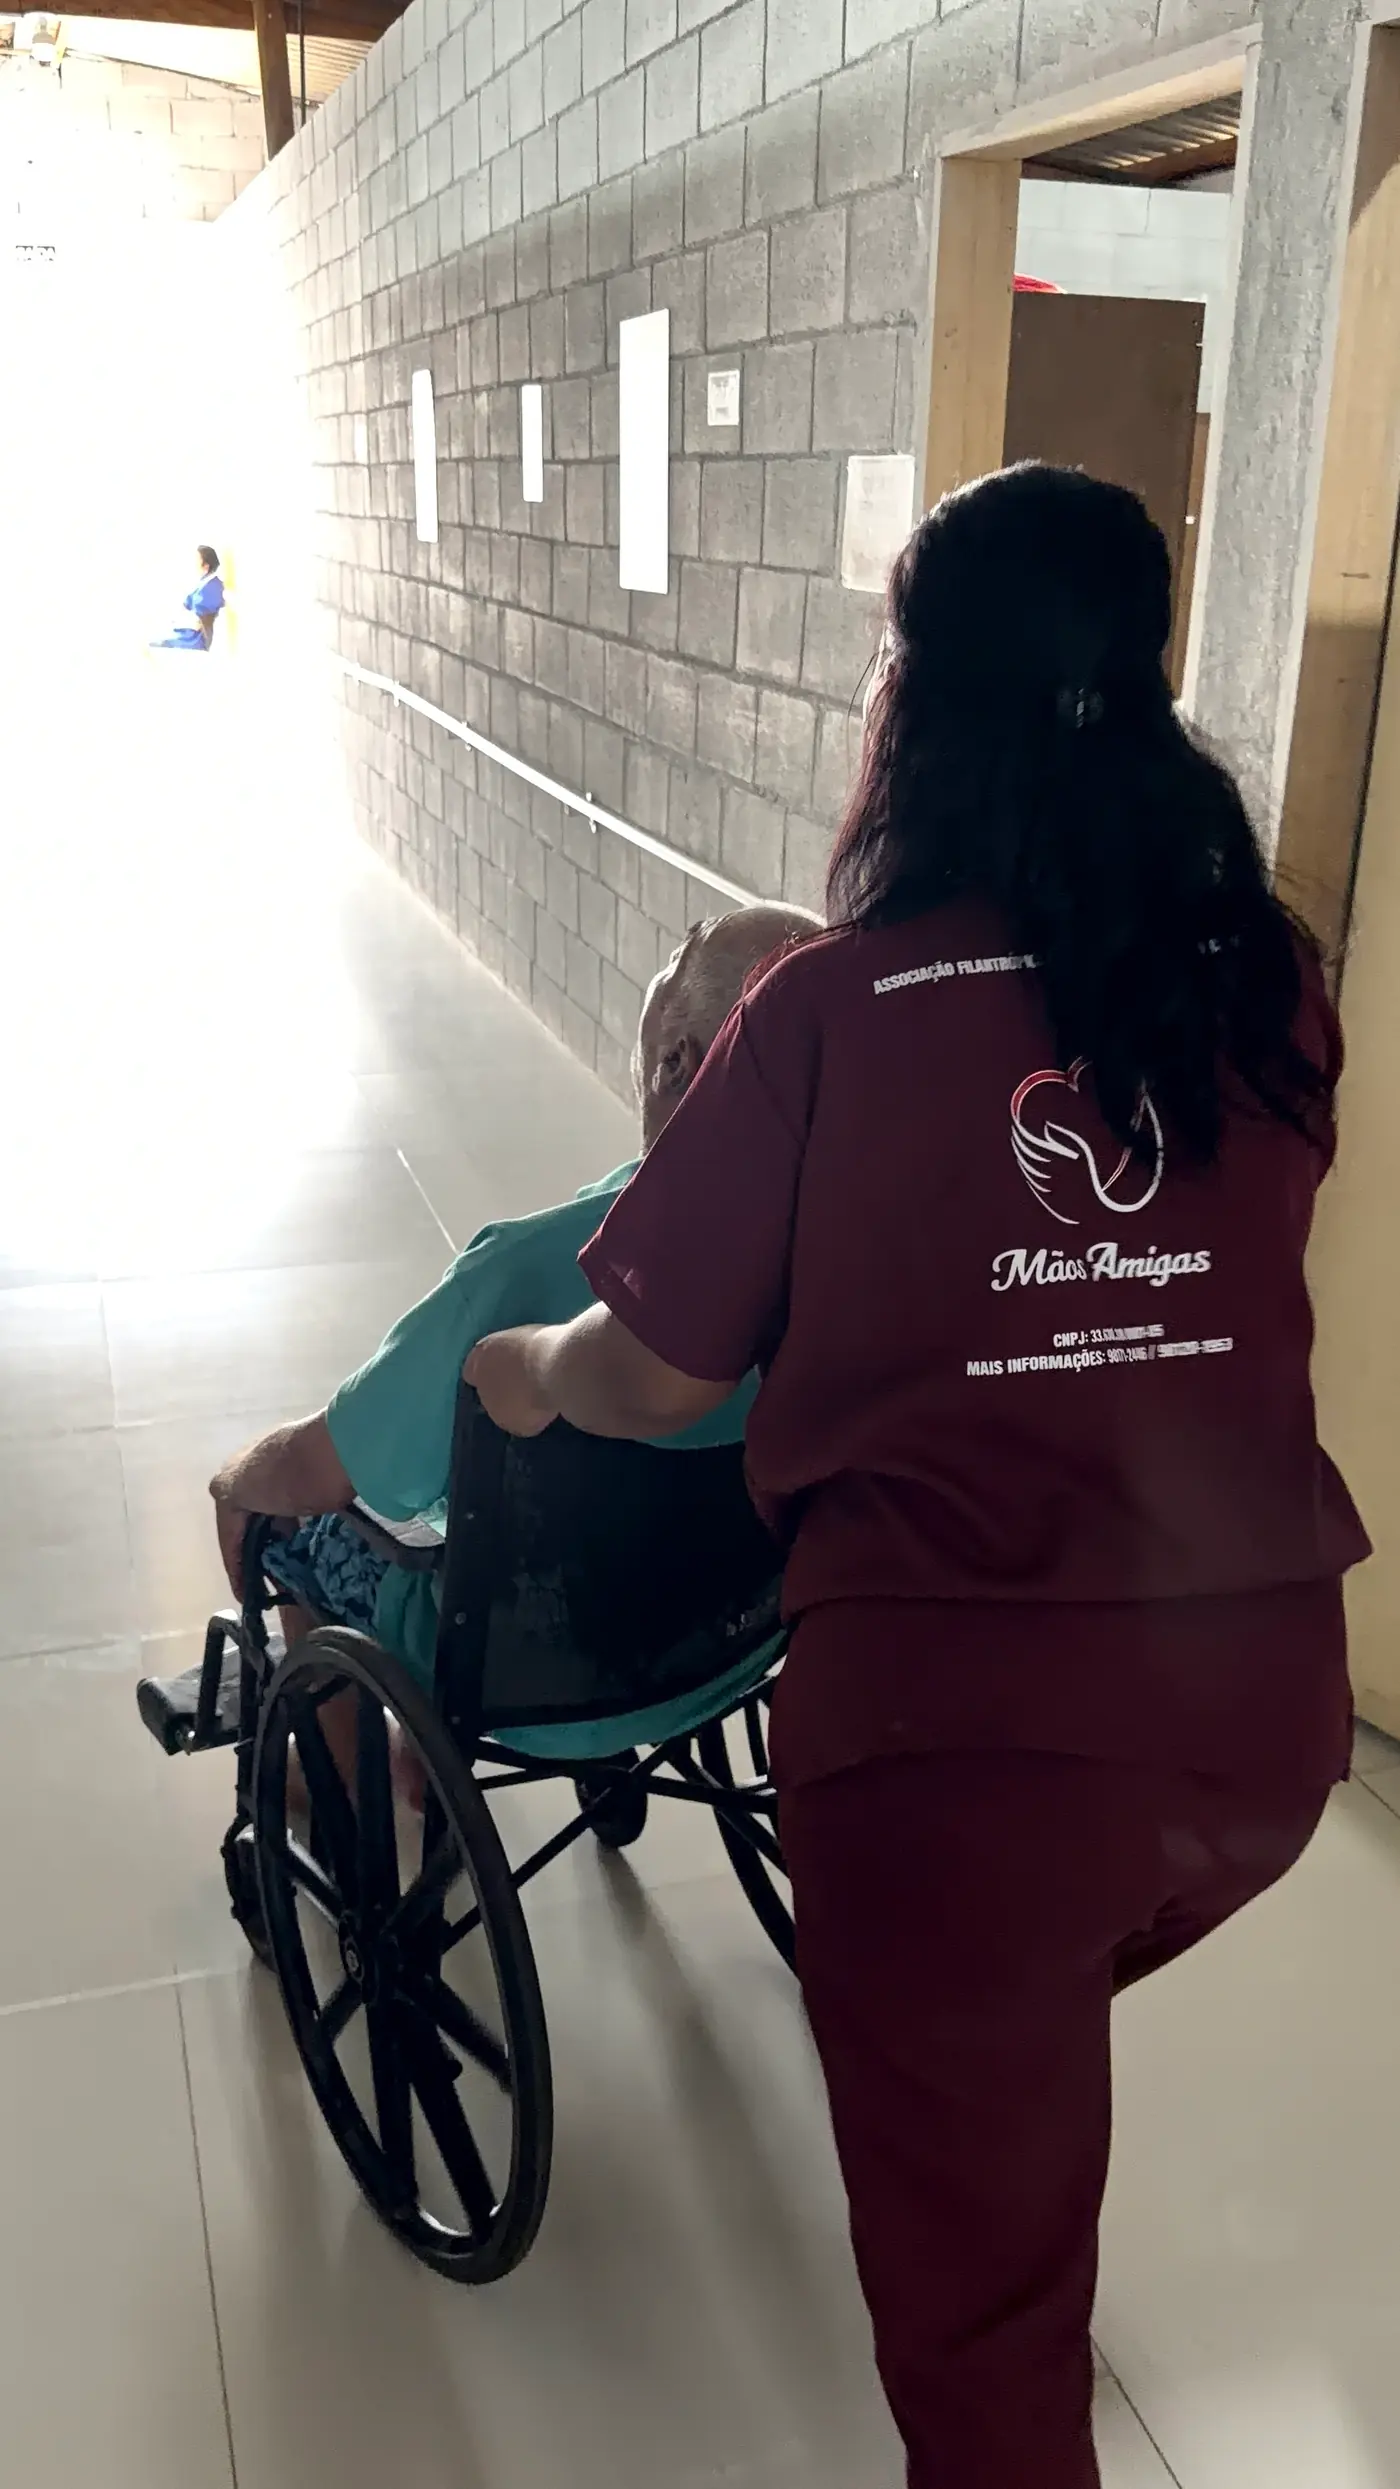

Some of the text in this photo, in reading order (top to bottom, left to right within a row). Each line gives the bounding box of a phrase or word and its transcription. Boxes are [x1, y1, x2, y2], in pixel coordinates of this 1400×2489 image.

[873, 951, 1041, 995] ASSOCIAÇÃO FILANTRÓPIC
[990, 1242, 1212, 1293] Mãos Amigas
[1053, 1329, 1089, 1348] CNPJ:
[966, 1358, 1004, 1376] MAIS
[1007, 1347, 1106, 1373] INFORMAÇÕES:
